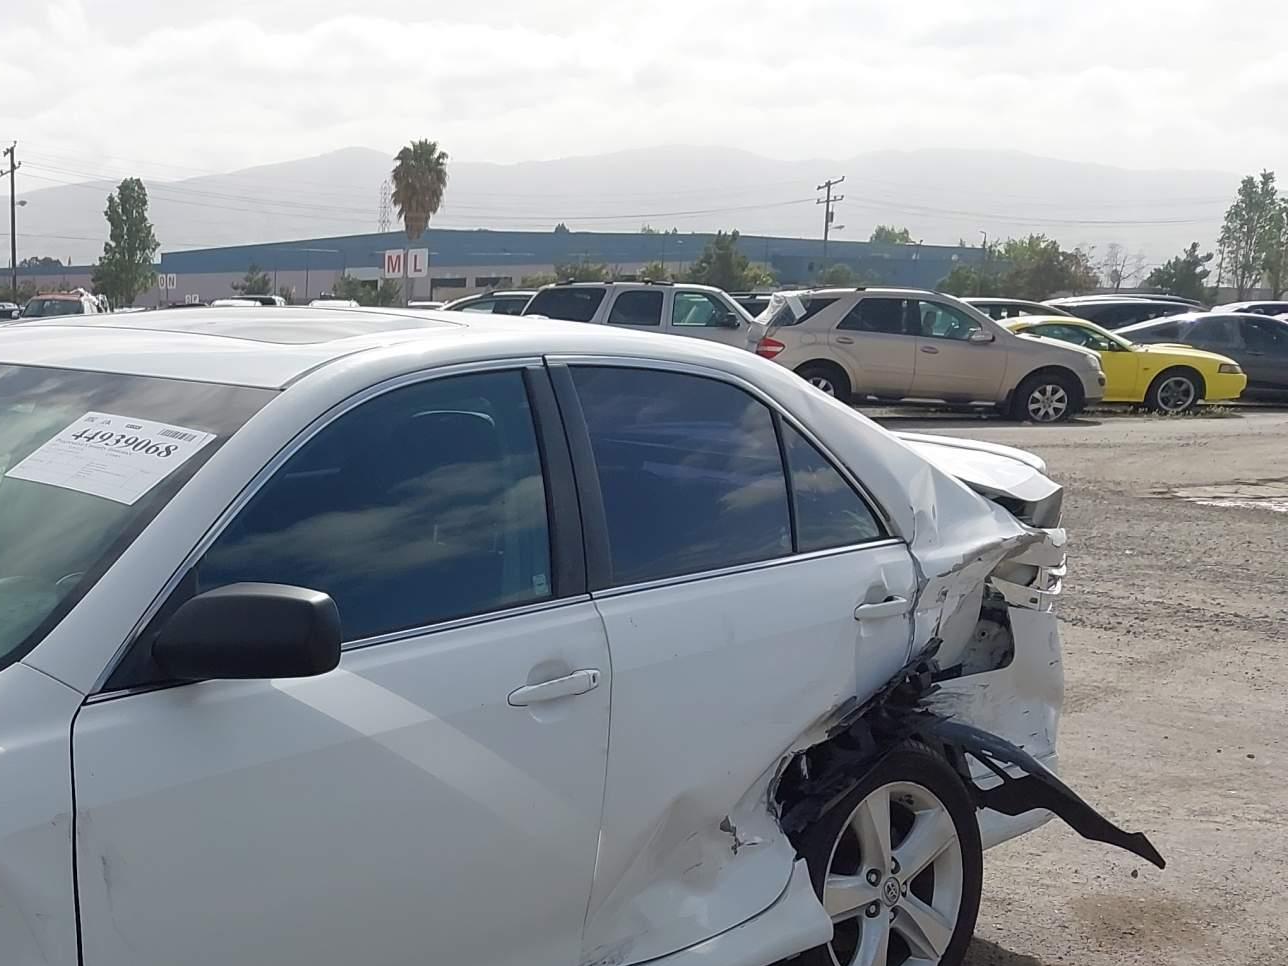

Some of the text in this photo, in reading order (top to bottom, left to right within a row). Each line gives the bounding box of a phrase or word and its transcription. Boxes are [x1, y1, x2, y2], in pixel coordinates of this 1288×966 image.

[387, 254, 423, 273] M L
[72, 428, 178, 458] 44939068
